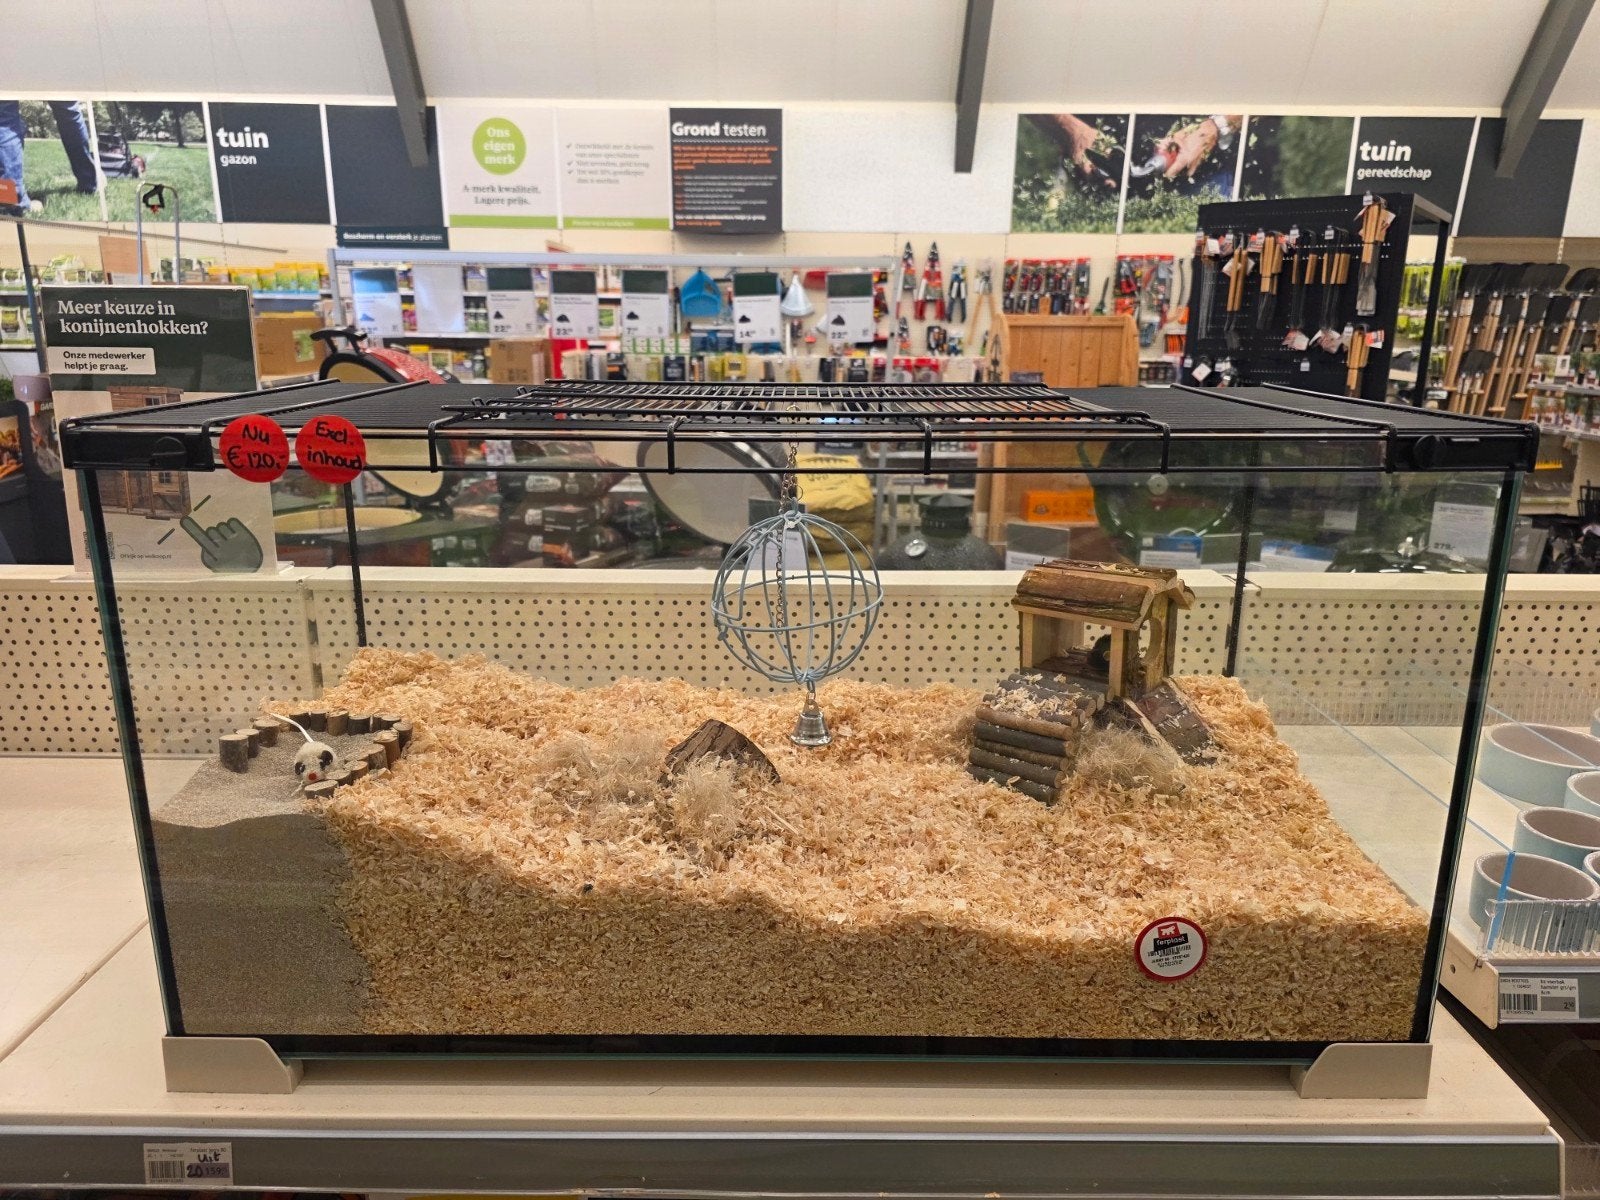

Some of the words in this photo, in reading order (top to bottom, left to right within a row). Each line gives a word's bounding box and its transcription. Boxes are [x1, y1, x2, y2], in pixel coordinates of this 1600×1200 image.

[486, 127, 511, 138] Ons
[672, 121, 720, 136] Grond
[722, 123, 767, 137] testen
[216, 126, 269, 148] tuin
[483, 140, 515, 153] eigen
[1360, 140, 1412, 161] tuin
[220, 155, 257, 167] gazon
[484, 154, 516, 165] merk
[1357, 166, 1432, 180] gereedschap
[58, 300, 101, 315] Meer
[104, 300, 155, 315] keuze
[158, 301, 176, 315] in
[60, 318, 208, 337] konijnenhokken?
[63, 351, 86, 359] Onze
[88, 351, 146, 360] medewerker
[64, 362, 87, 371] helpt
[89, 362, 98, 371] je
[99, 363, 129, 371] graag.
[242, 424, 270, 445] Nu
[315, 421, 354, 445] Excl.
[306, 445, 363, 470] inhoud
[1156, 934, 1186, 946] ferplast
